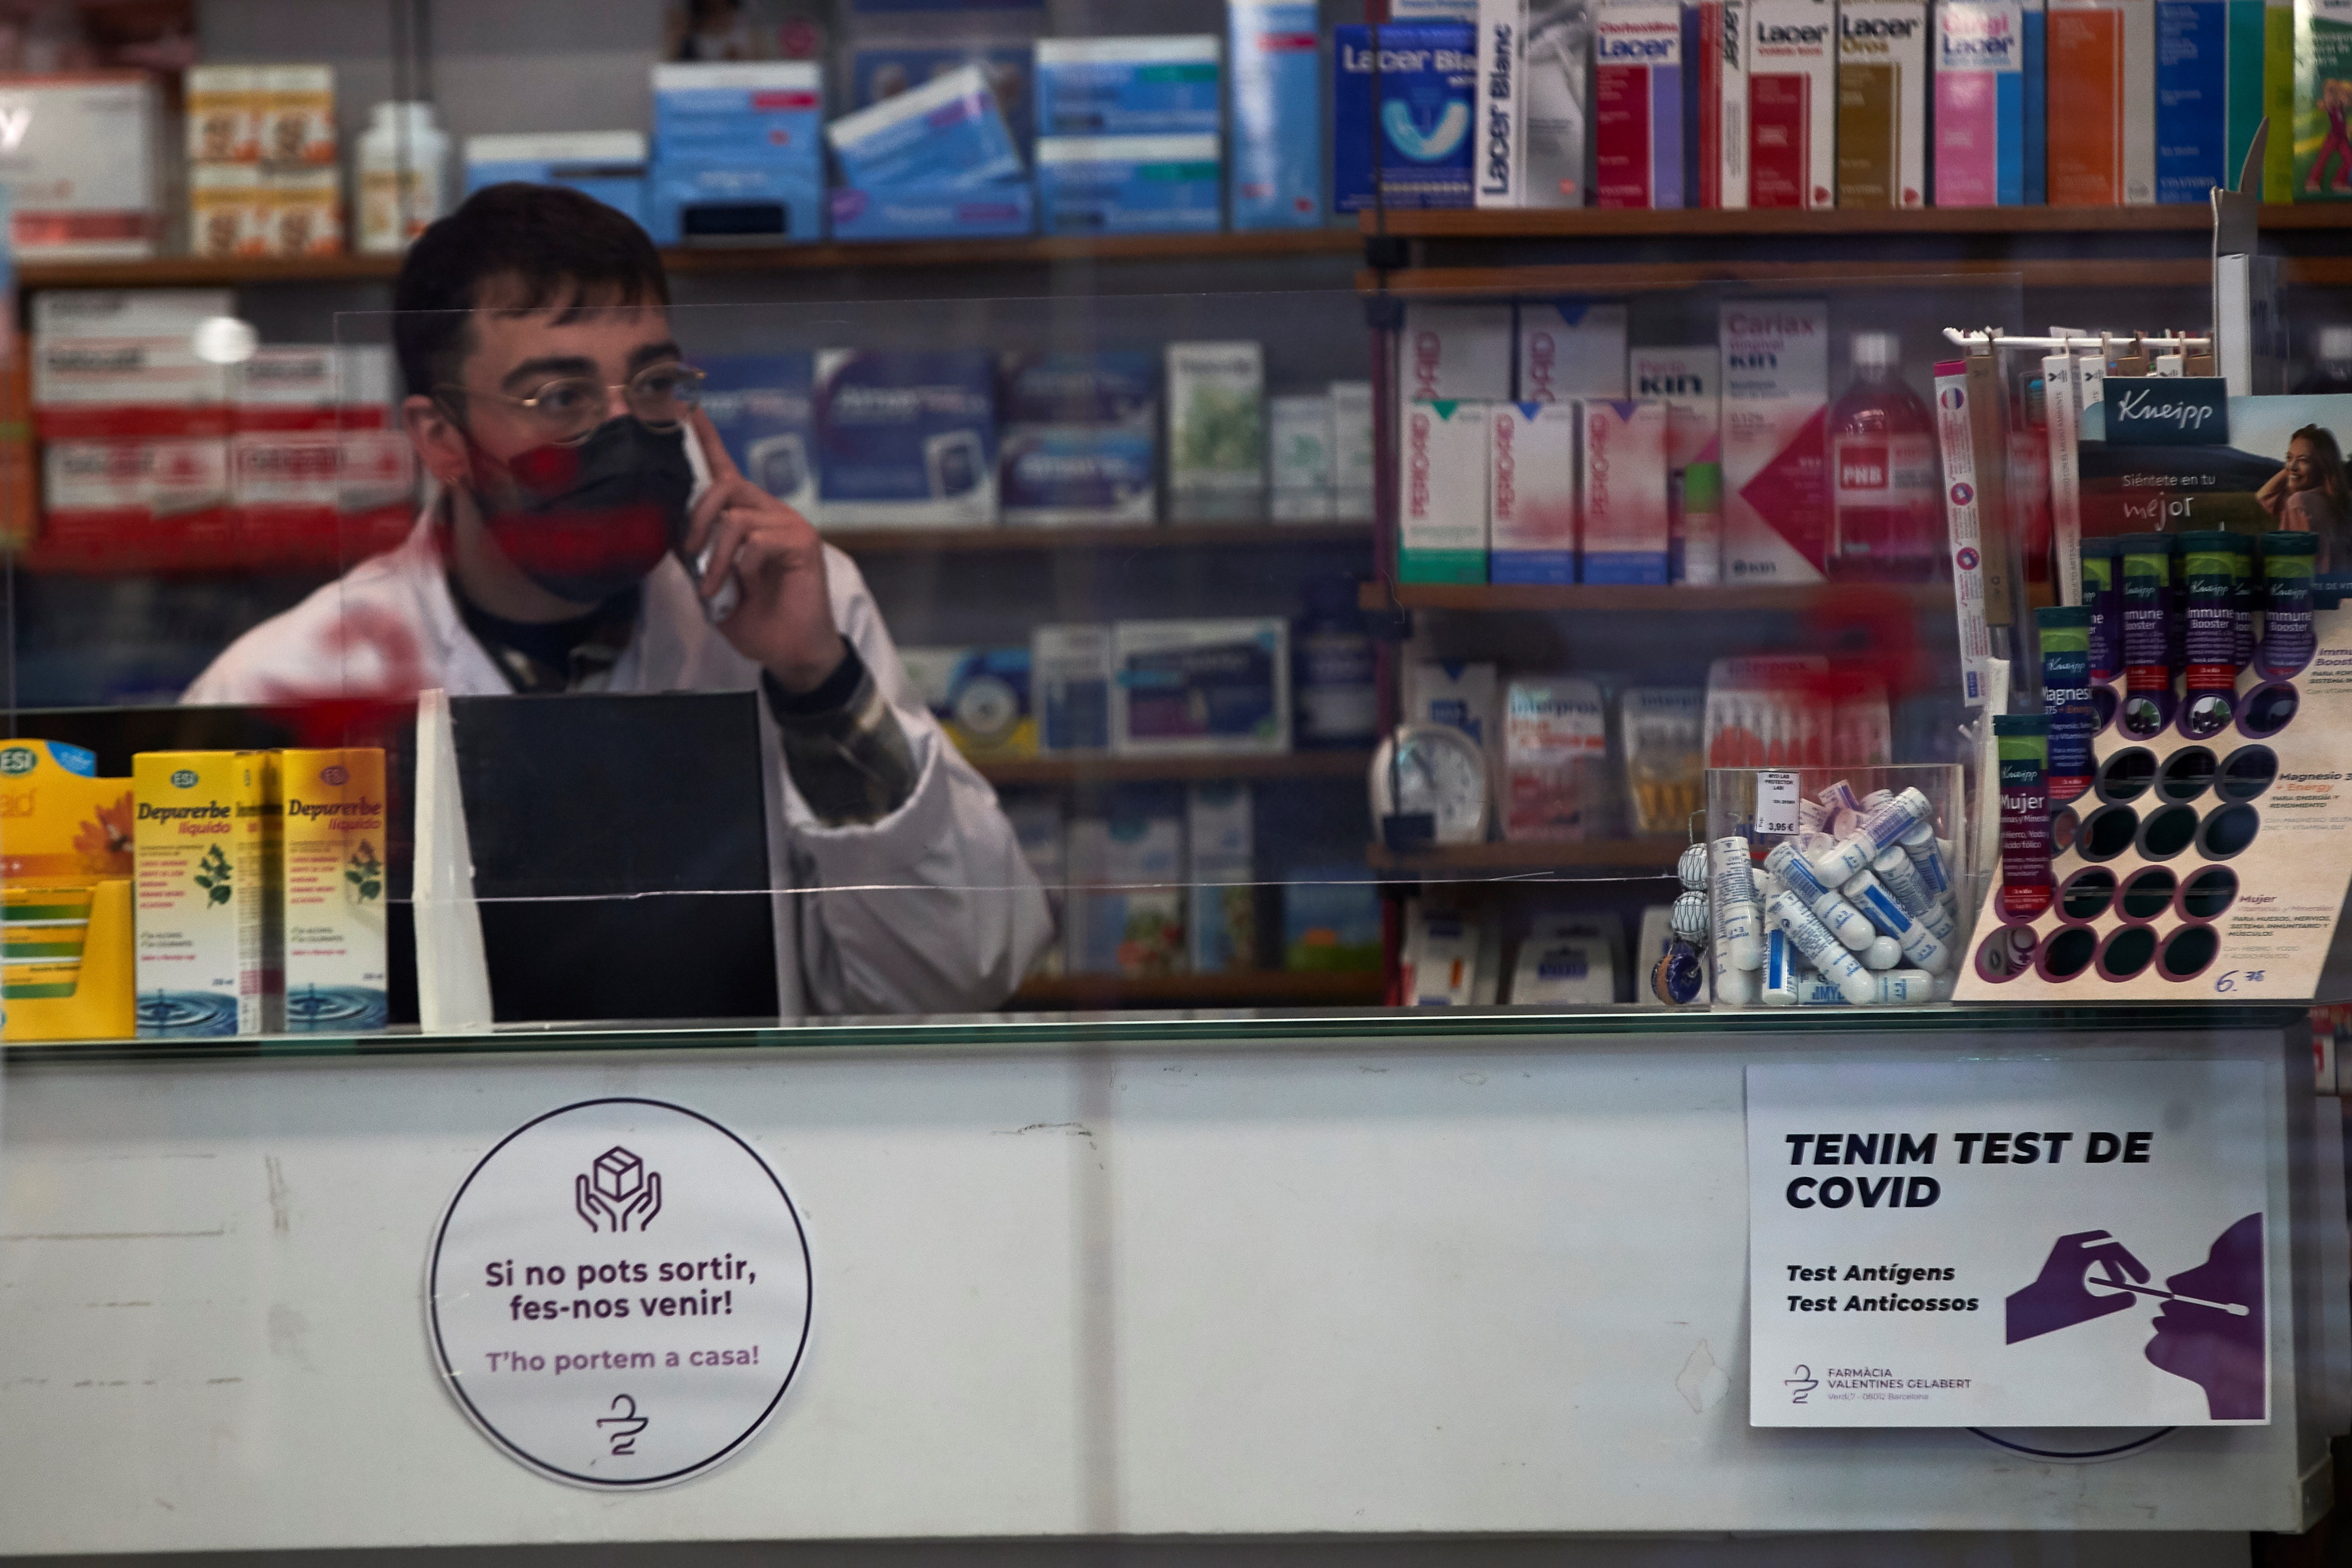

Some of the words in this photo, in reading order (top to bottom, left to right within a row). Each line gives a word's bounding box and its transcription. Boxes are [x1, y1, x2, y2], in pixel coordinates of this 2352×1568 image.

[1757, 20, 1829, 43] Lacer
[1841, 14, 1919, 38] Lacer
[1599, 36, 1675, 58] Lacer
[1482, 105, 1509, 194] Lacer
[2118, 389, 2213, 429] Kneipp
[2122, 473, 2178, 486] Siéntete
[2180, 476, 2198, 486] en
[2201, 474, 2216, 485] tu
[2124, 492, 2194, 532] mejor
[174, 772, 196, 786] ESI
[2279, 771, 2342, 782] Magnesio
[2287, 784, 2335, 792] Energy
[137, 800, 231, 825] Depurerbe
[289, 796, 381, 821] Depurerbe
[2001, 793, 2045, 814] Mujer
[1768, 823, 1787, 832] 3,95
[1788, 823, 1794, 831] €
[2239, 895, 2278, 904] Mujer
[1785, 1133, 1939, 1165] TENIM
[1954, 1131, 2074, 1165] TEST
[2085, 1131, 2154, 1164] DE
[1785, 1176, 1942, 1210] COVID
[486, 1259, 514, 1287] Si
[526, 1263, 565, 1286] no
[577, 1260, 648, 1290] pots
[658, 1253, 757, 1286] sortir,
[1786, 1265, 1837, 1282] Test
[1844, 1262, 1956, 1285] Antígens
[509, 1295, 630, 1321] fes-nos
[640, 1289, 733, 1317] venir!
[1786, 1295, 1837, 1313] Test
[1844, 1293, 1980, 1313] Anticossos
[555, 1349, 656, 1376] portem
[665, 1351, 680, 1366] a
[689, 1345, 760, 1367] casa!
[1828, 1366, 1893, 1378] FARMÀCIA
[1828, 1379, 1904, 1389] VALENTINES
[1907, 1379, 1972, 1389] GELABERT
